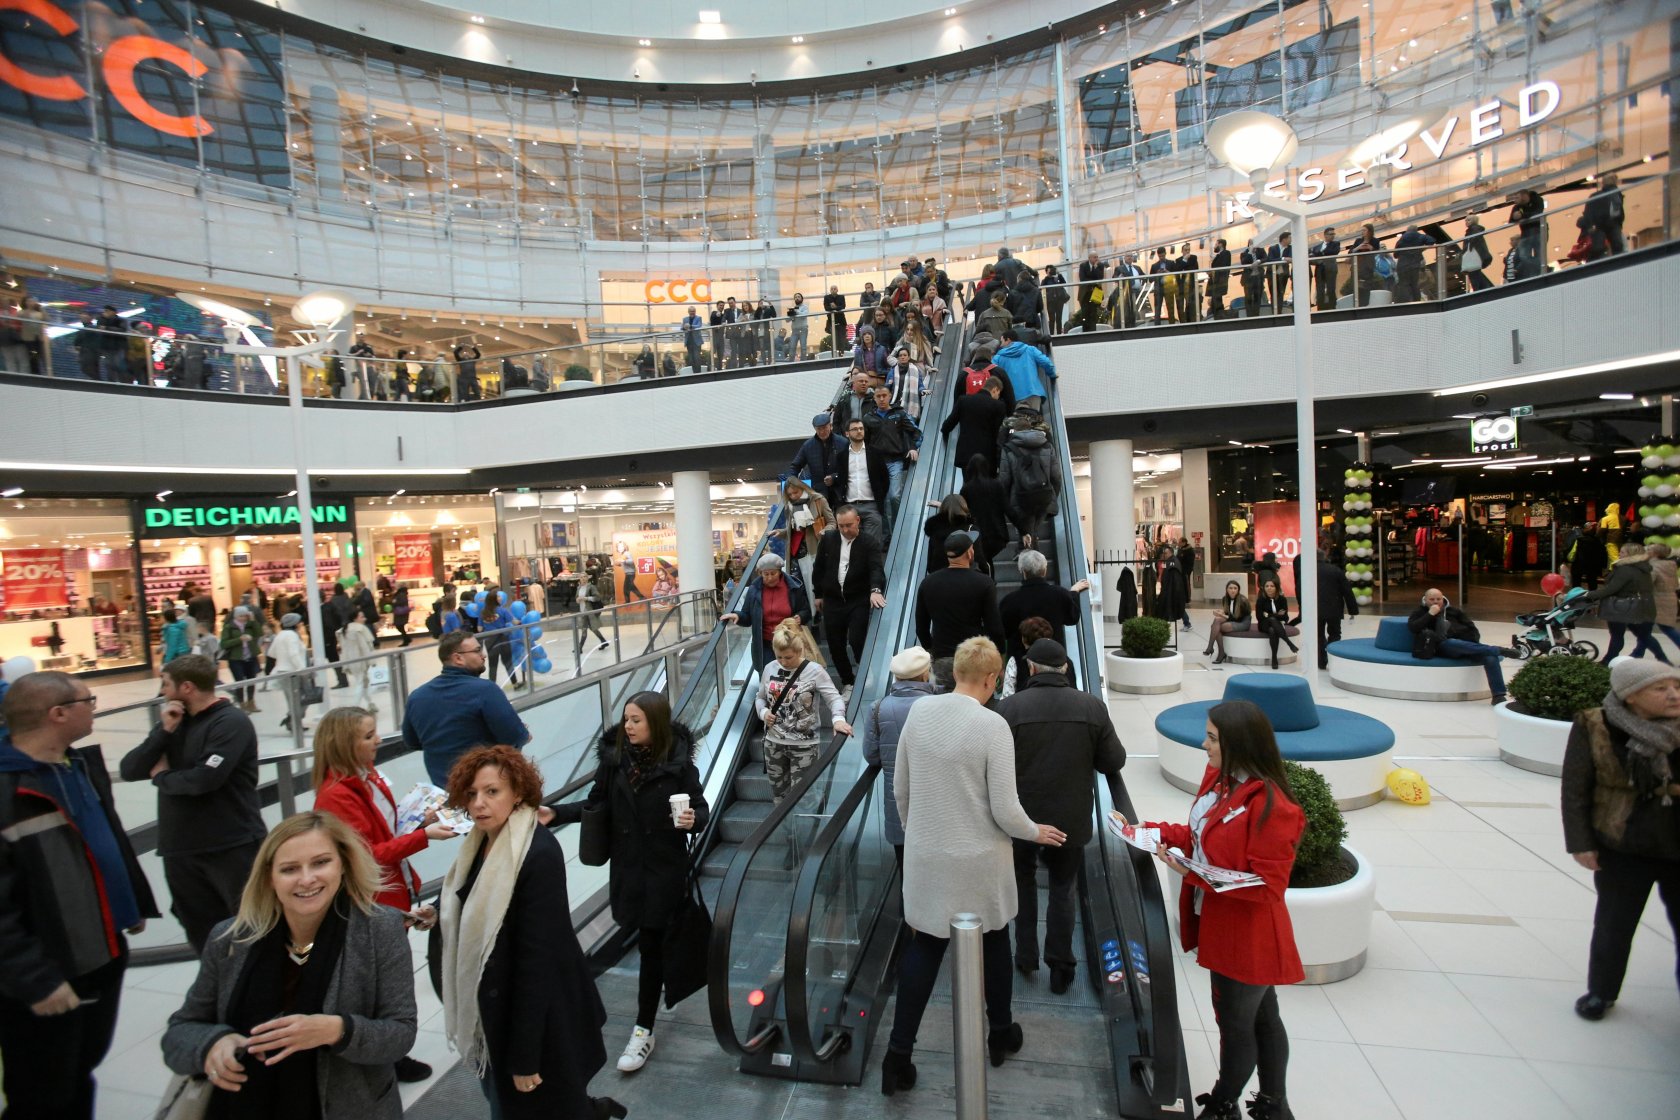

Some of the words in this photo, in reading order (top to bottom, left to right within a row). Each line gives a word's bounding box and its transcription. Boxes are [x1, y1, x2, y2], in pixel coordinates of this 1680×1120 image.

[645, 279, 712, 303] CCC
[1472, 416, 1517, 444] GO
[1474, 442, 1516, 453] SPORT
[145, 505, 347, 528] DEICHMANN
[5, 563, 63, 581] 20%
